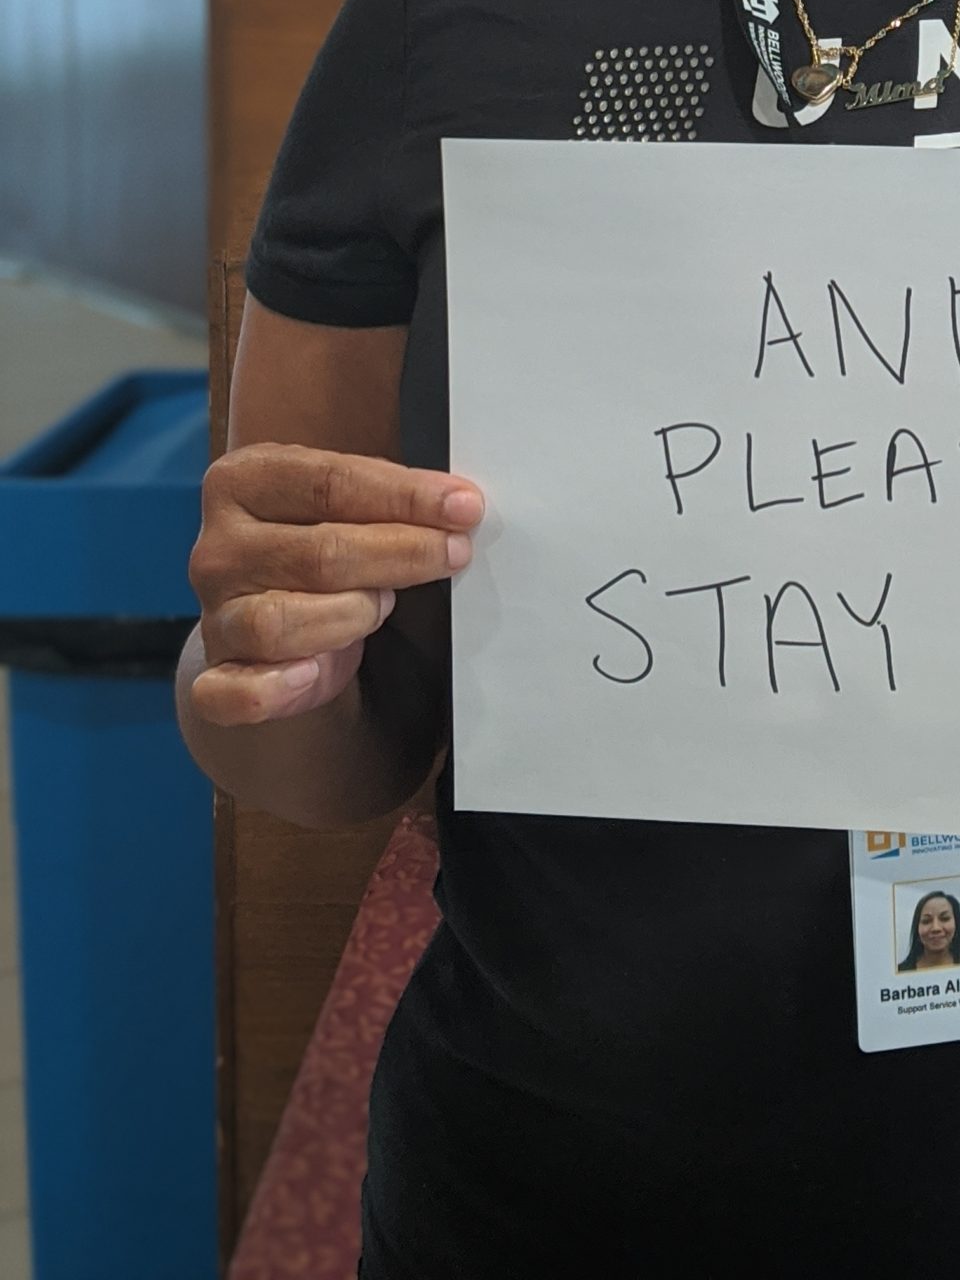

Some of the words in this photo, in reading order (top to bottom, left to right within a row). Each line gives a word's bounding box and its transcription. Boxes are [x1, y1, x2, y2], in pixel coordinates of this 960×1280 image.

[585, 568, 897, 694] STAY
[880, 984, 940, 1002] Barbara
[897, 1004, 928, 1015] Support
[929, 1000, 957, 1011] Service
